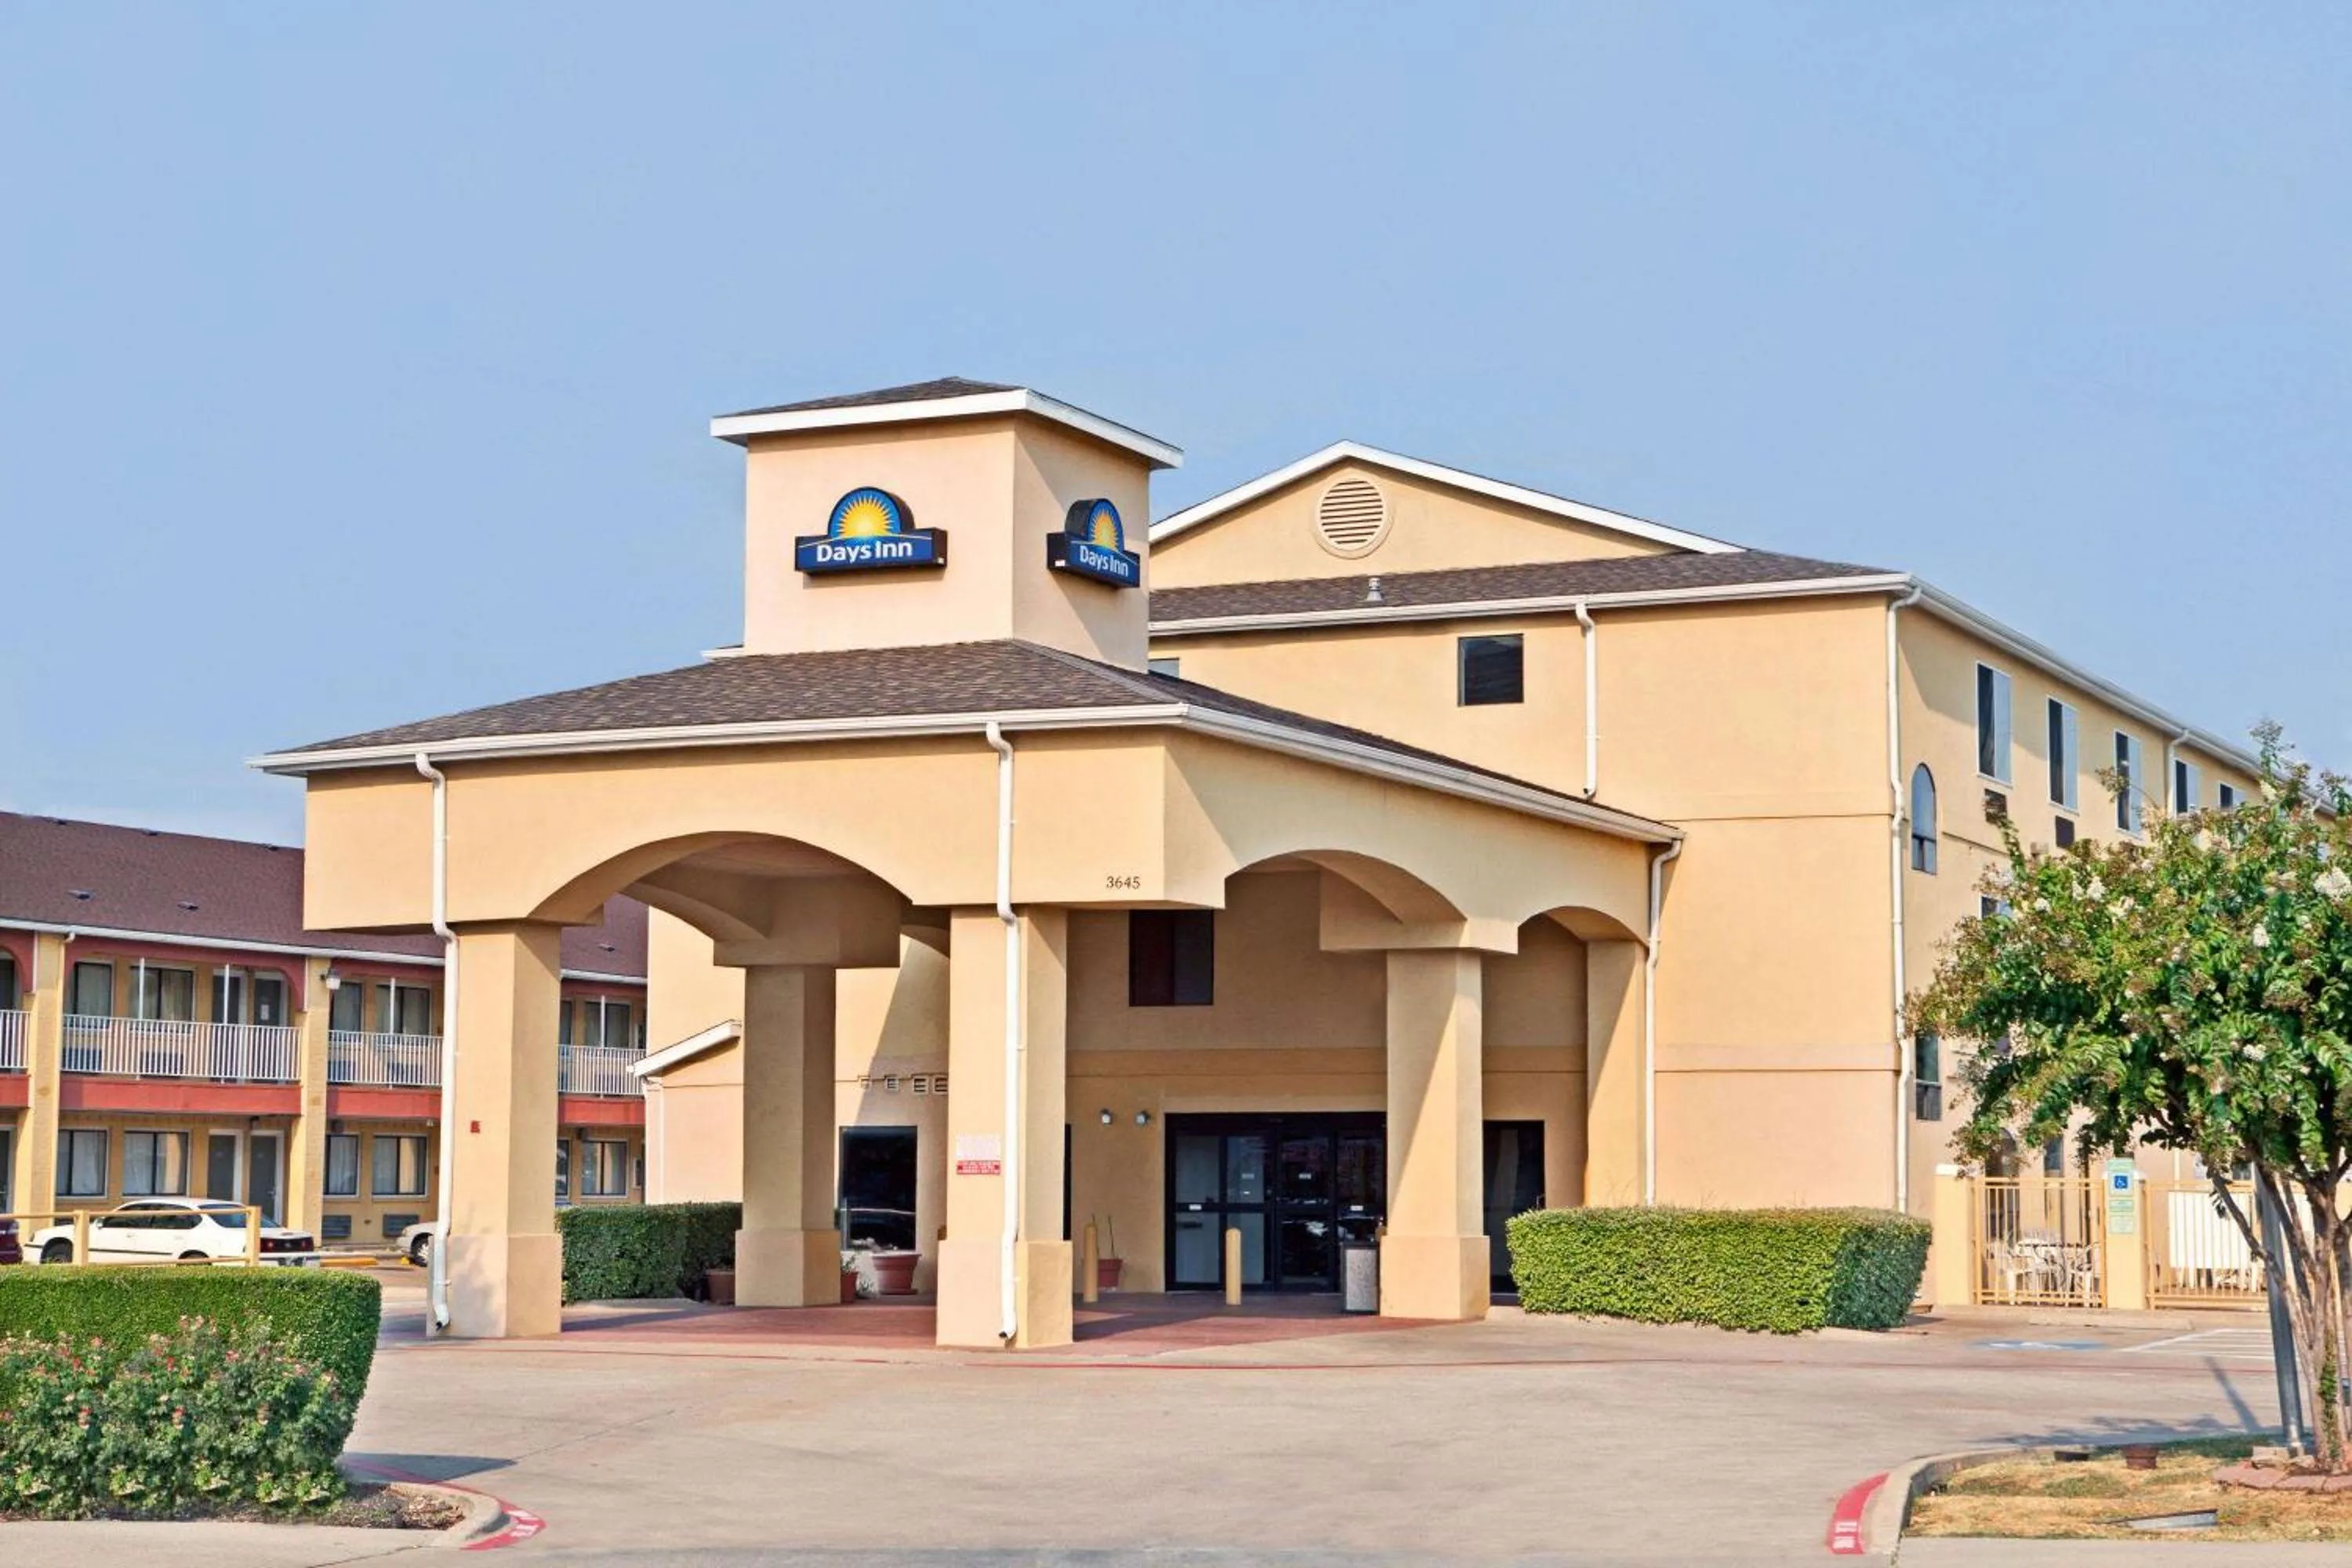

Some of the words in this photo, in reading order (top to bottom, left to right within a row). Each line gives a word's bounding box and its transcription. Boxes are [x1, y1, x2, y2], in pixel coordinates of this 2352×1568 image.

[816, 544, 872, 564] Days
[875, 540, 913, 559] Inn
[1080, 545, 1109, 571] Days
[1109, 554, 1128, 577] Inn
[1106, 875, 1141, 890] 3645
